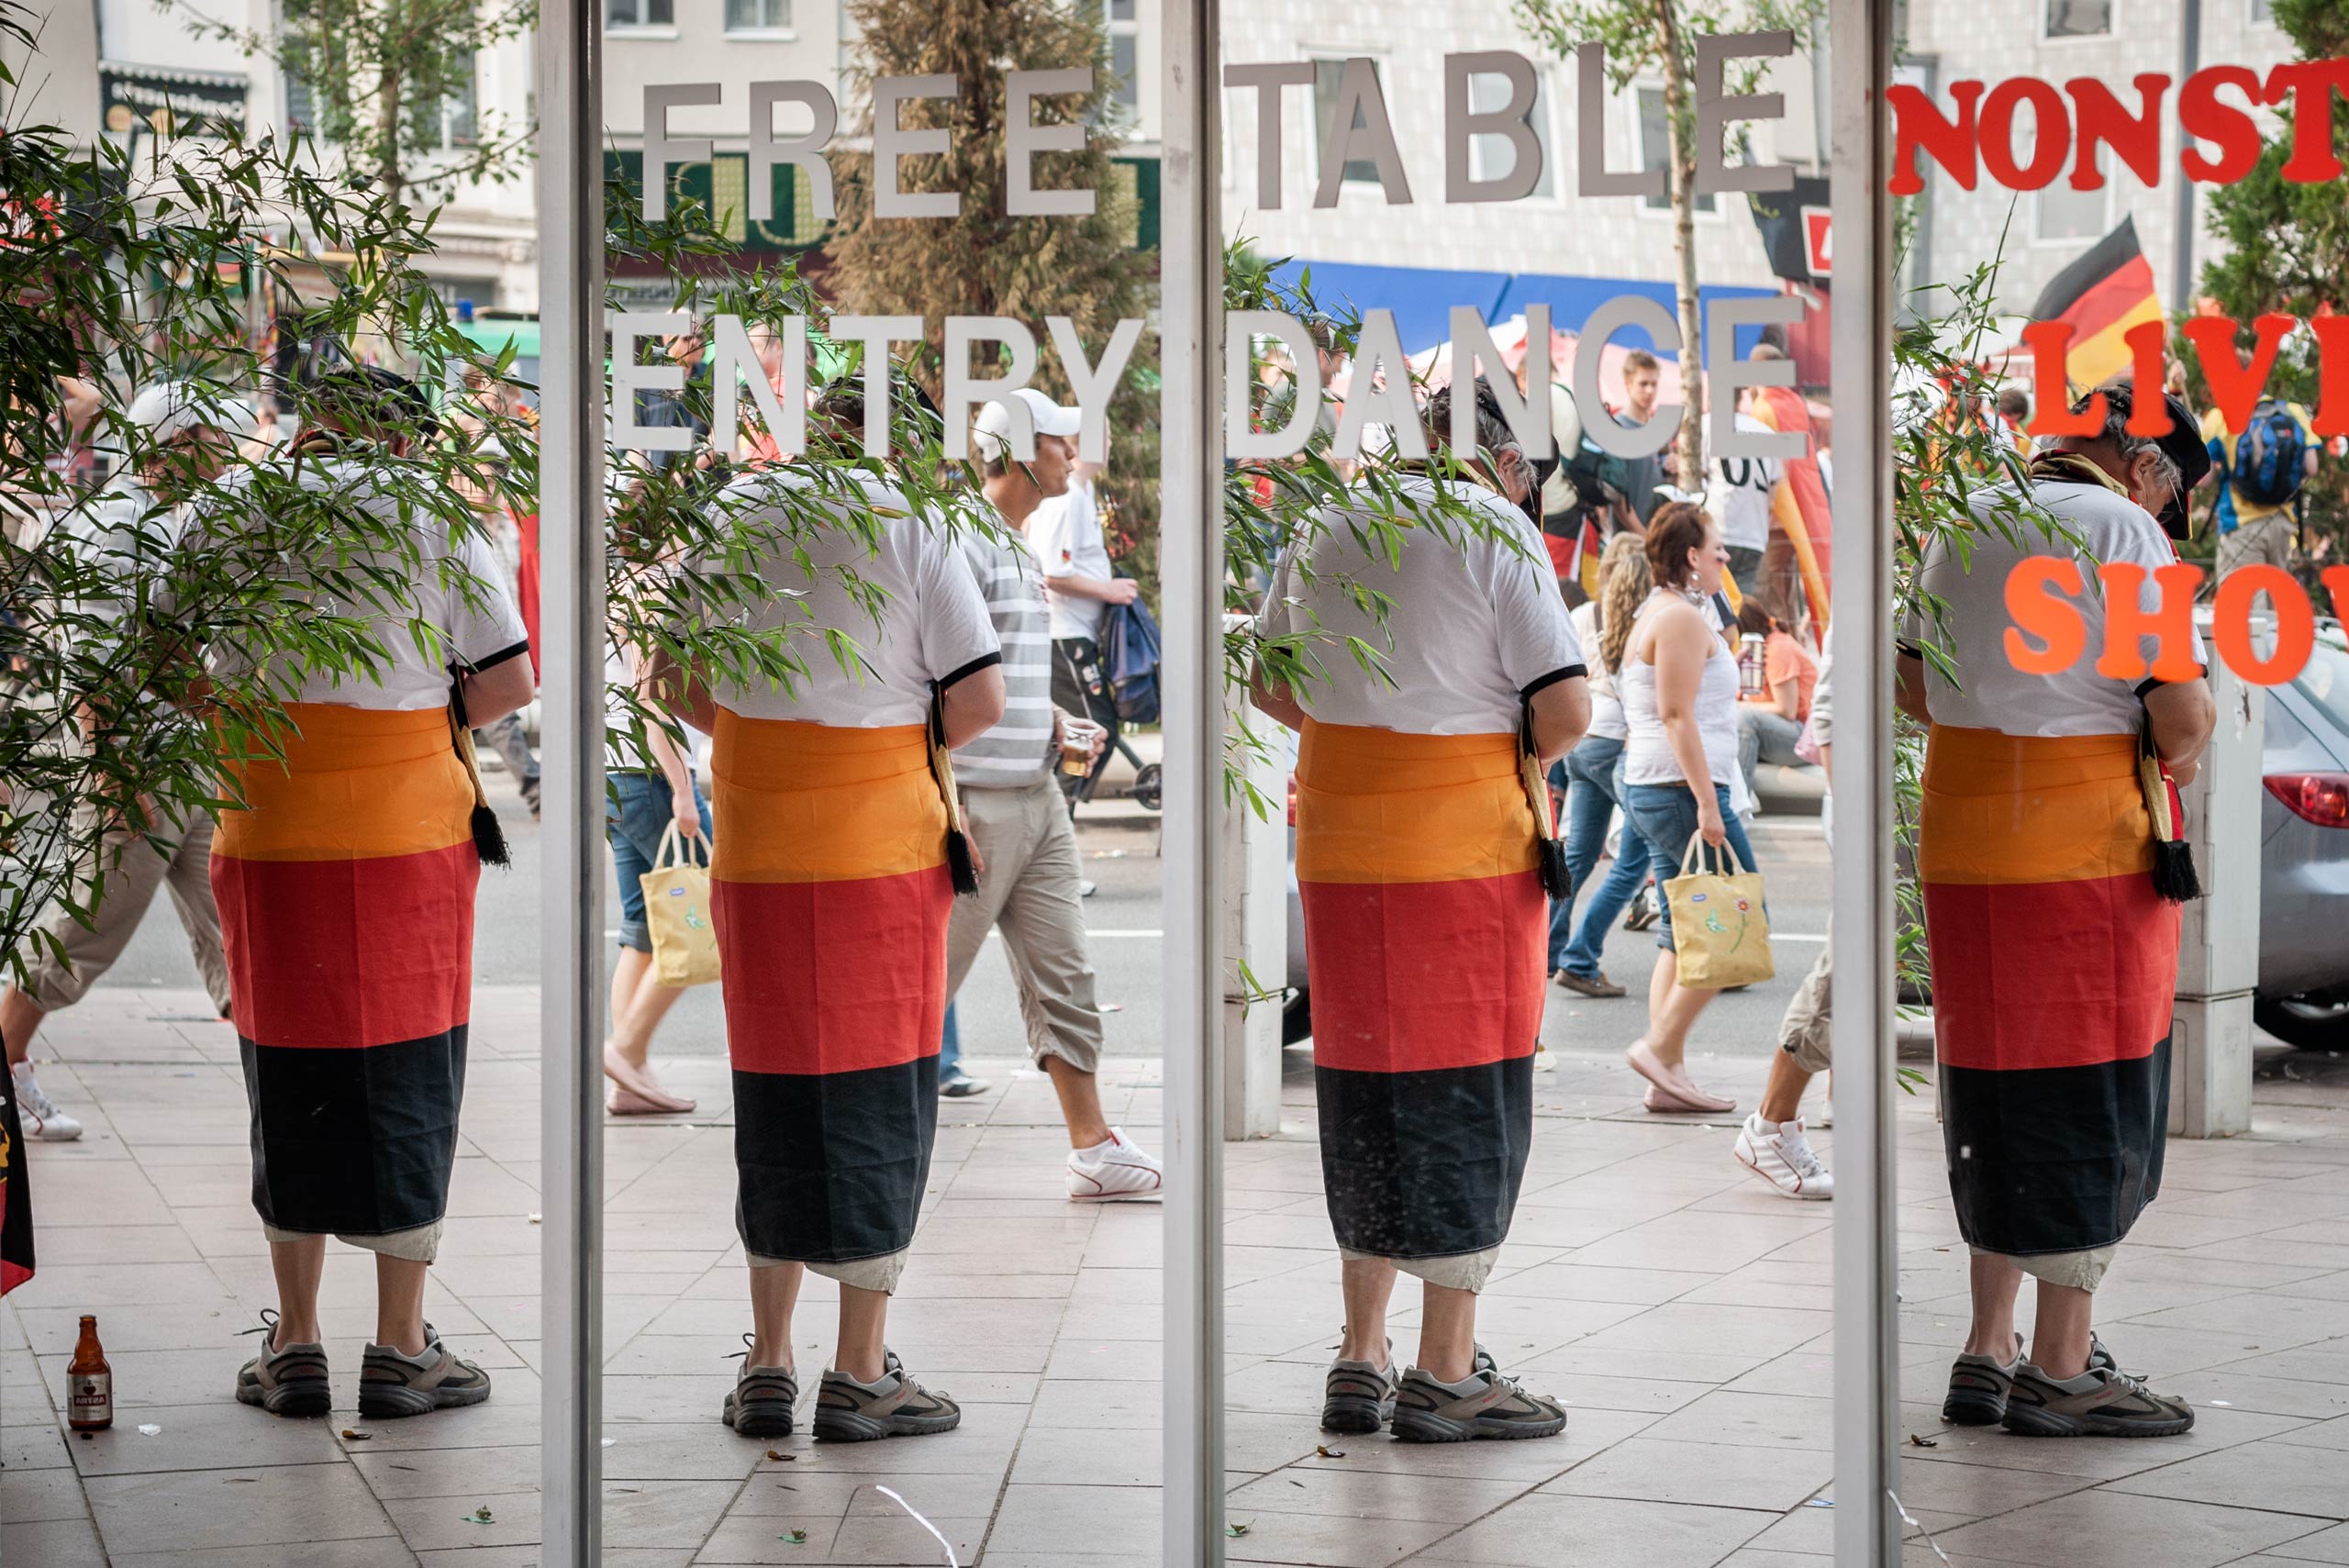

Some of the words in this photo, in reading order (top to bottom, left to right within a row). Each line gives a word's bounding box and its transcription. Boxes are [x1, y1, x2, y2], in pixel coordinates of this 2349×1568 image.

[642, 68, 1097, 221] FREE
[1223, 30, 1795, 210] TABLE
[1887, 56, 2349, 196] NONST
[611, 313, 1146, 464] ENTRY
[1225, 295, 1808, 460] DANCE
[2004, 556, 2349, 685] SHO
